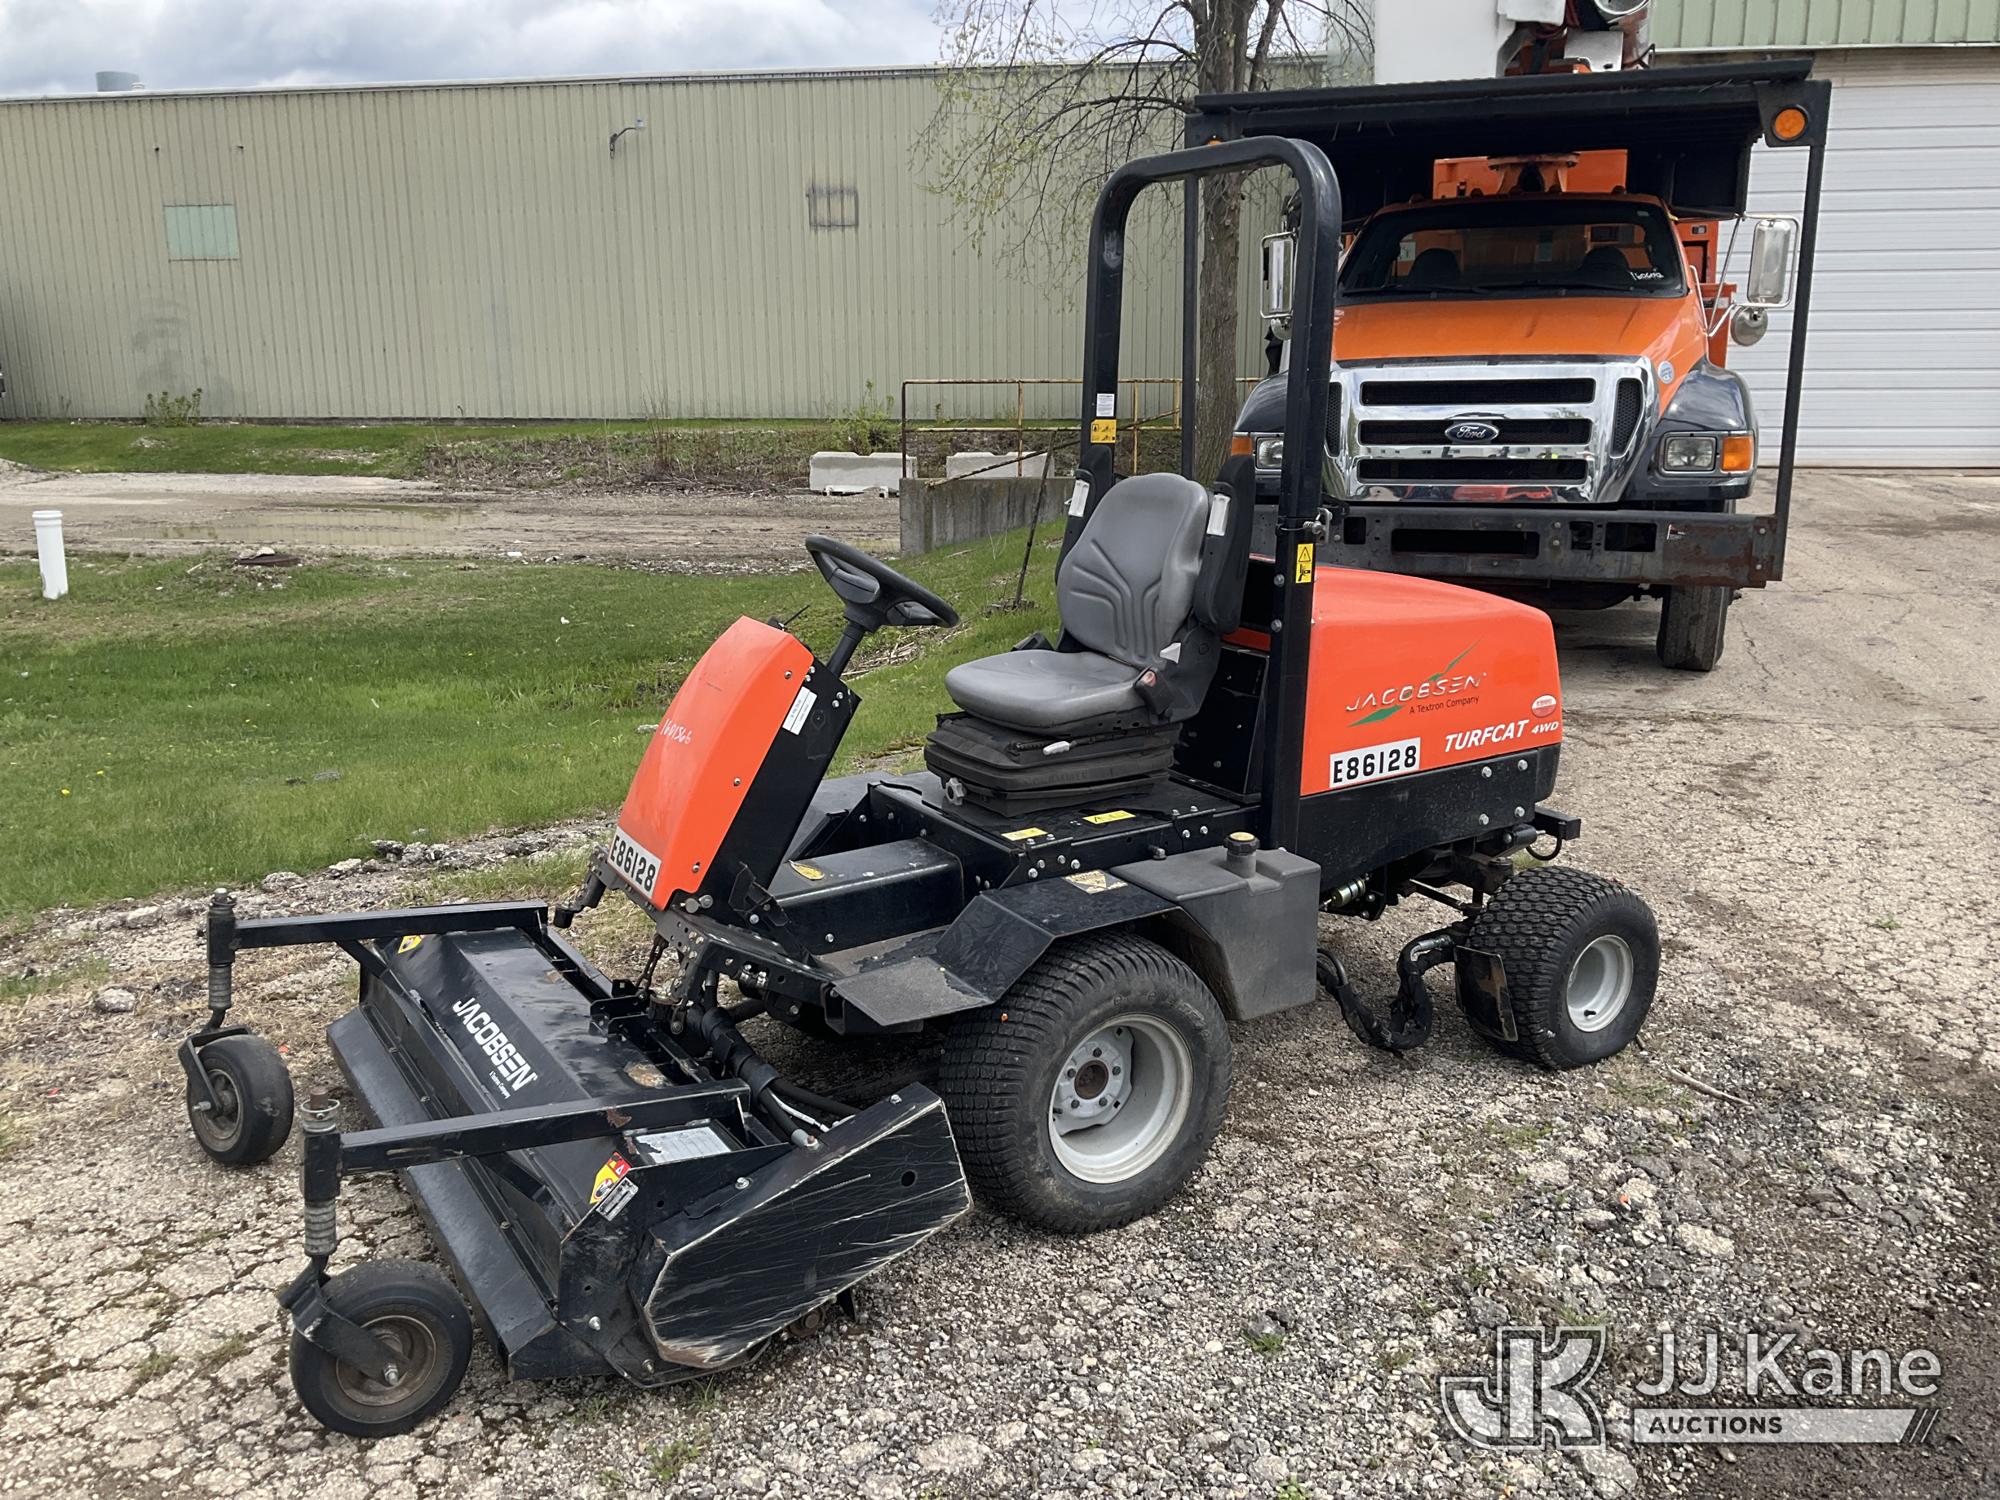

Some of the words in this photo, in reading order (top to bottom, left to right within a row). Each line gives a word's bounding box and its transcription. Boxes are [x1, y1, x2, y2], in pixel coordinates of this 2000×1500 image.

[1456, 426, 1487, 438] Ford
[1345, 674, 1481, 711] JACOBSEN
[1409, 706, 1415, 714] A
[1417, 702, 1444, 713] Textron
[1446, 696, 1480, 707] Company
[1445, 719, 1529, 752] TURFCAT
[1531, 721, 1559, 734] 4WD
[1333, 745, 1417, 783] E86128
[610, 835, 656, 897] E86128
[452, 998, 538, 1091] JACOBSEN
